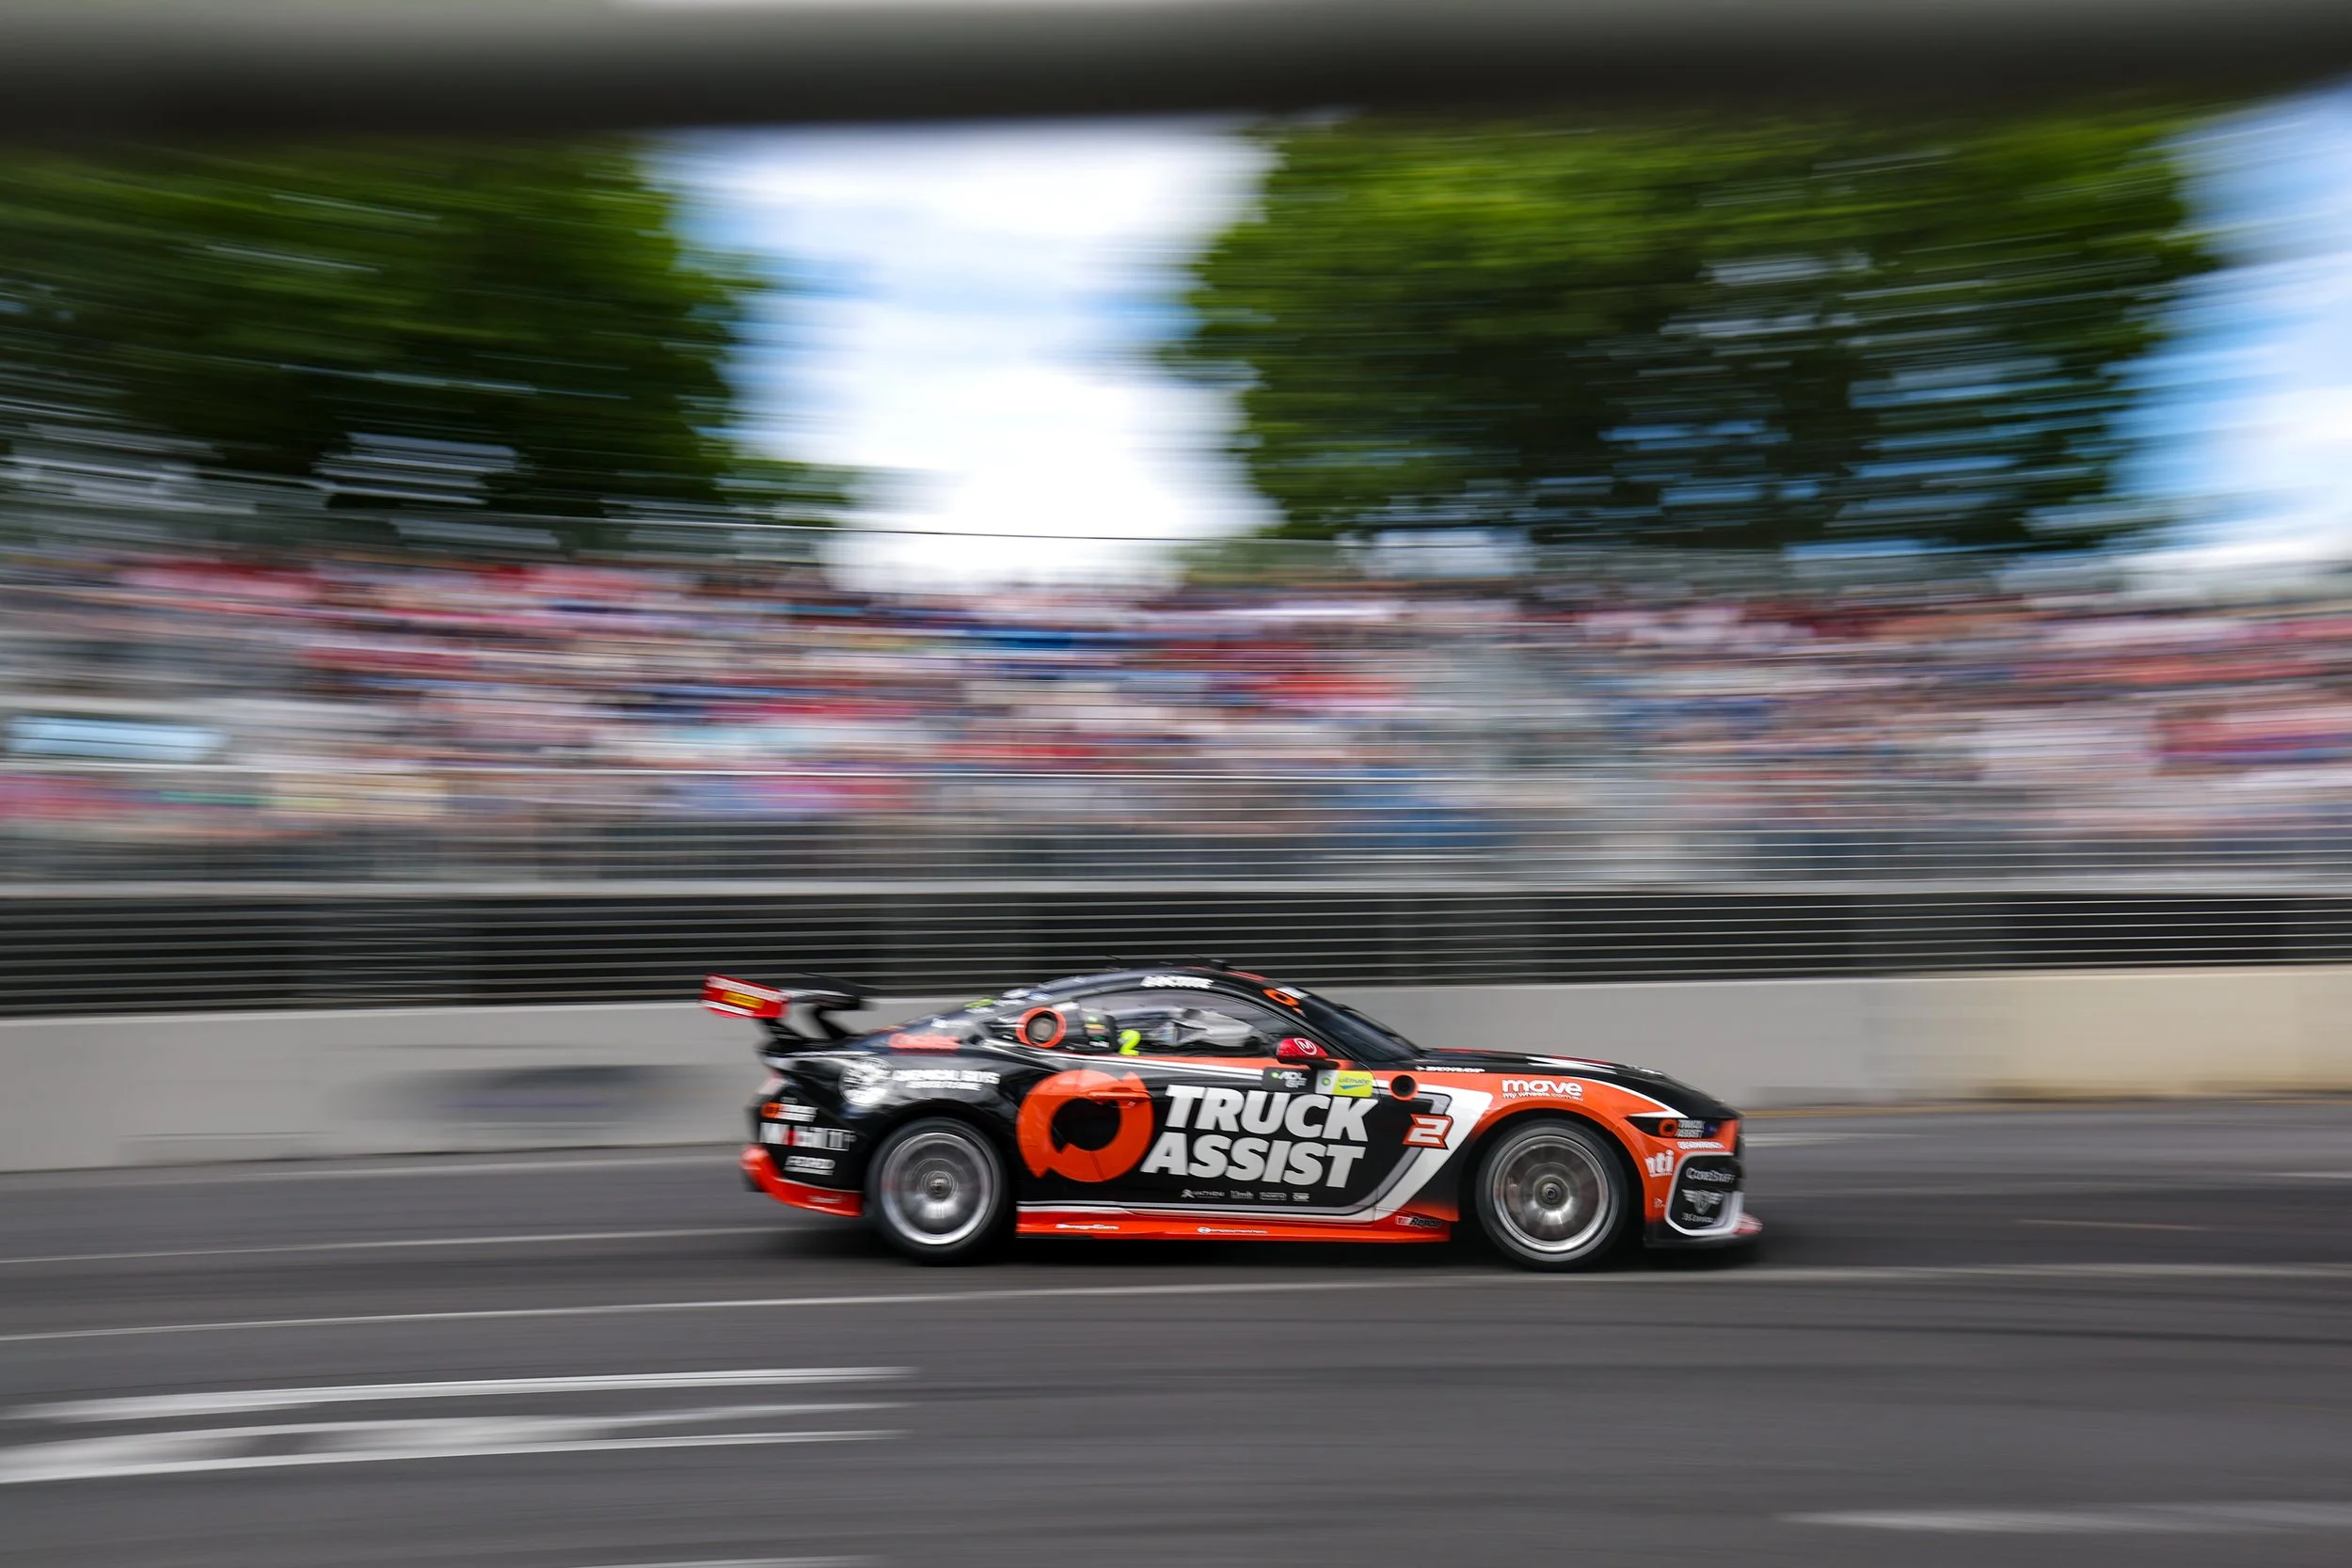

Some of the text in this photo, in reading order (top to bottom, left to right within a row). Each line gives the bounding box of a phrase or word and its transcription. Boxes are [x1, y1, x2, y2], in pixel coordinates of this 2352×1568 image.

[1119, 1029, 1141, 1056] 2
[1502, 1079, 1583, 1096] move
[1165, 1084, 1379, 1142] TRUCK
[1406, 1116, 1452, 1146] 2
[1139, 1132, 1366, 1188] ASSIST
